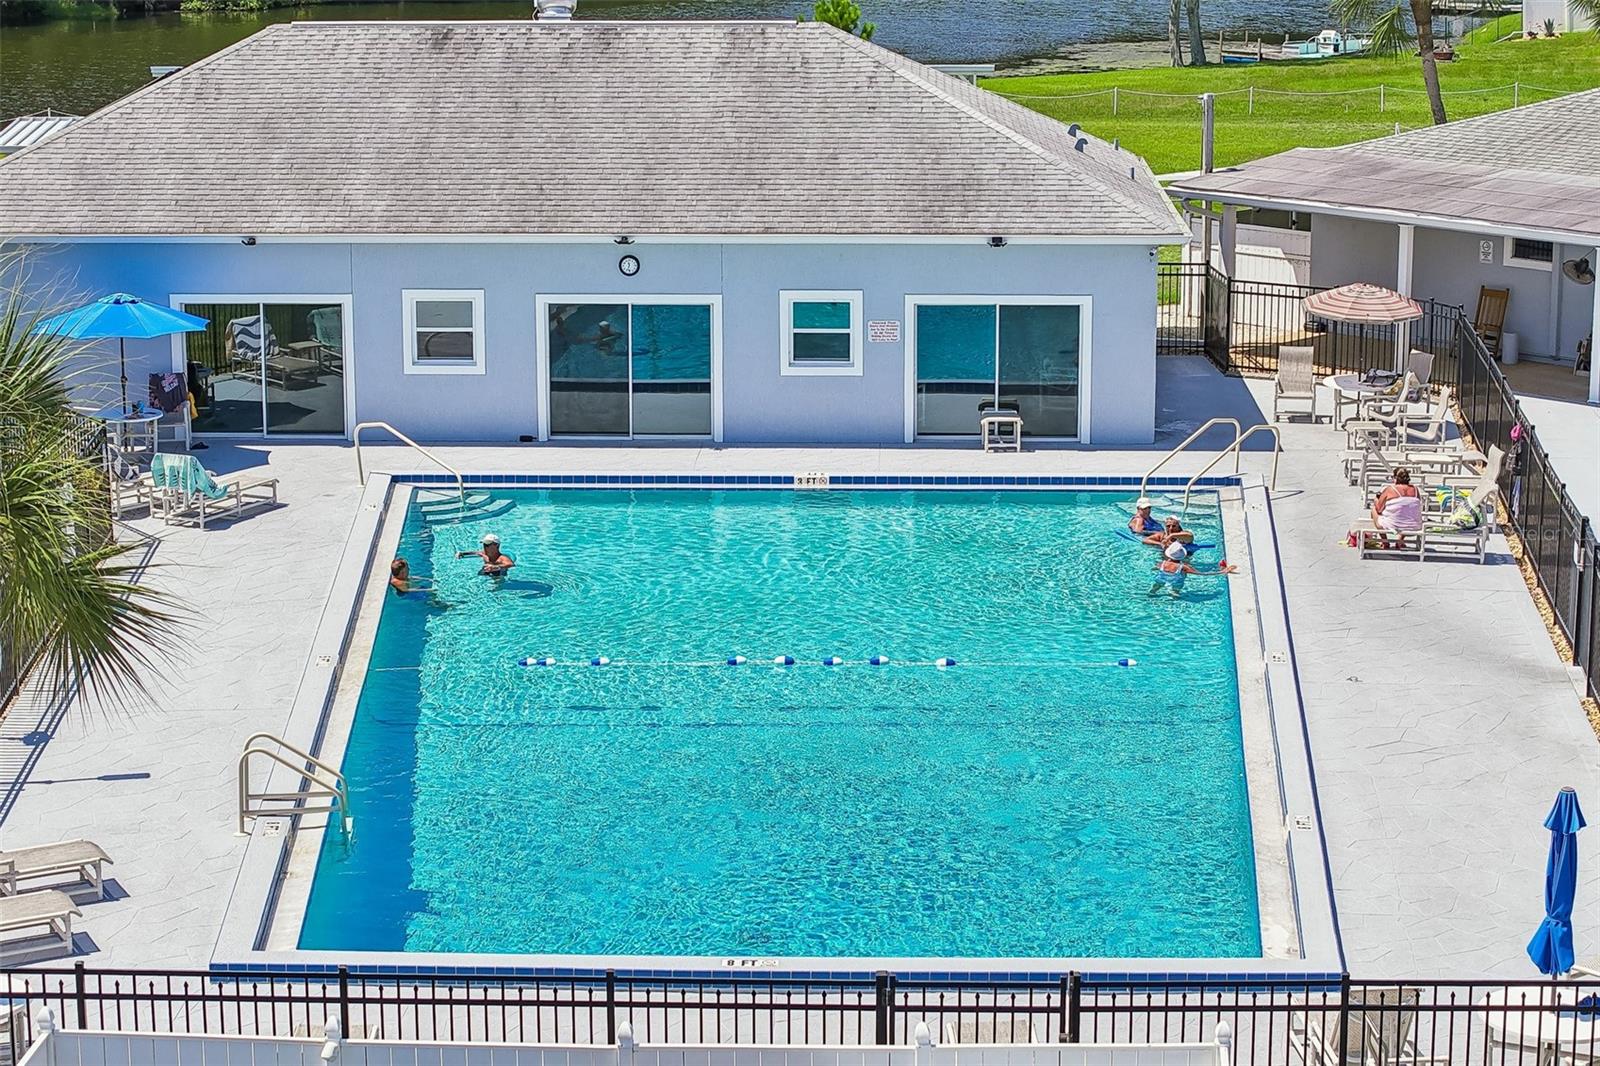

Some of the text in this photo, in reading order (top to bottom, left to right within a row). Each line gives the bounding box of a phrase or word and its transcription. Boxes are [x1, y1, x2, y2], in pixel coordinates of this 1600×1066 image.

[797, 477, 817, 485] 3 FT
[727, 959, 758, 967] 8 FT
